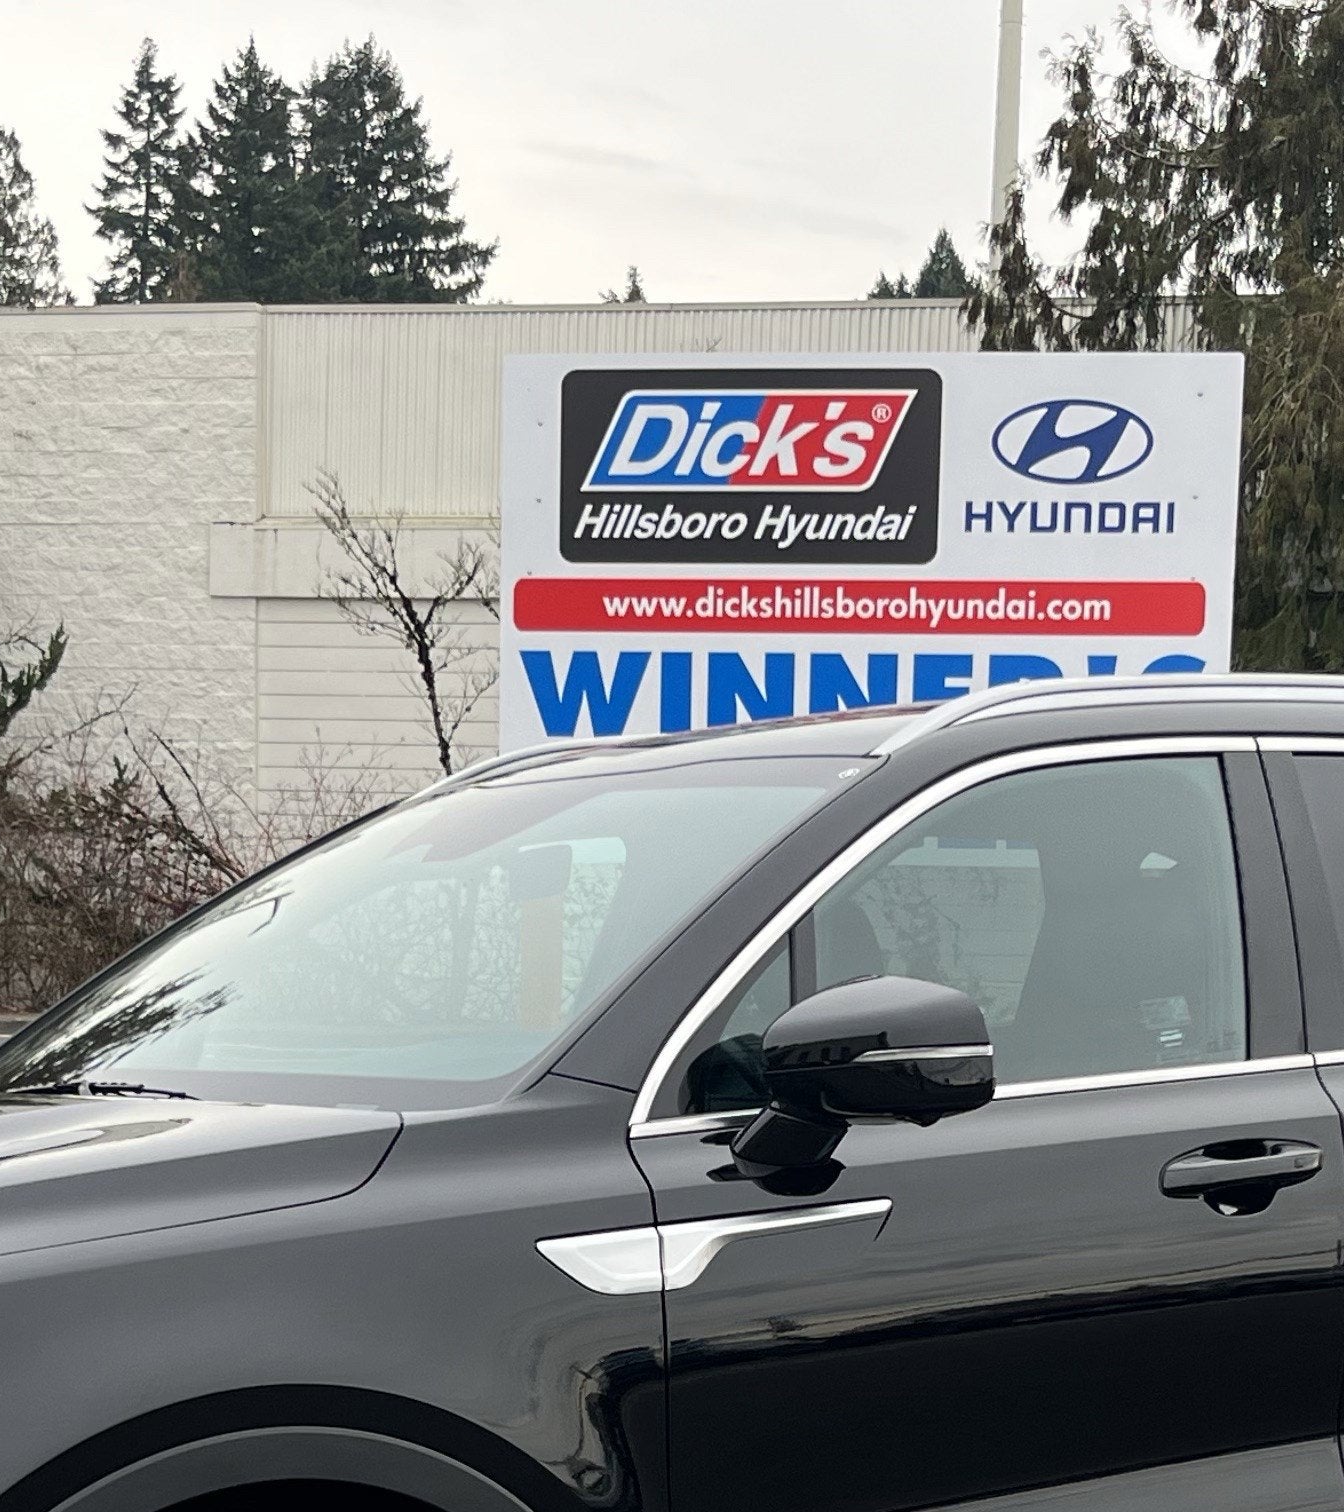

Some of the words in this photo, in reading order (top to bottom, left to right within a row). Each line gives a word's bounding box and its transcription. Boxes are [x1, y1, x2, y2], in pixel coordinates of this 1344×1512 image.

[607, 400, 875, 480] Dick's
[574, 504, 747, 543] Hillsboro
[753, 504, 918, 548] Hyundai
[965, 501, 1174, 534] HYUNDAI
[602, 582, 1112, 623] www.dickshillsborohyundai.com
[520, 649, 1206, 738] WINNE'
